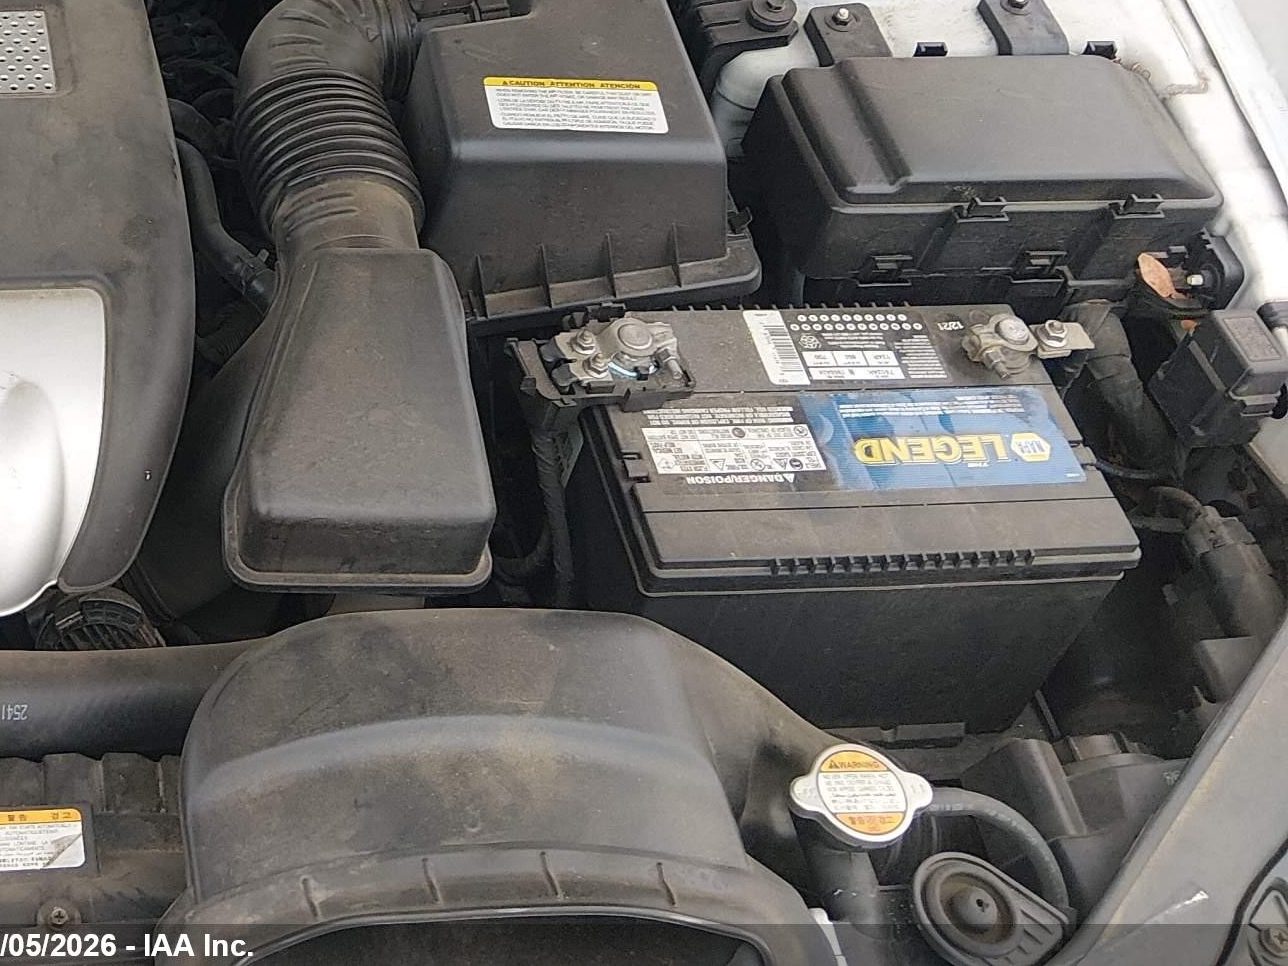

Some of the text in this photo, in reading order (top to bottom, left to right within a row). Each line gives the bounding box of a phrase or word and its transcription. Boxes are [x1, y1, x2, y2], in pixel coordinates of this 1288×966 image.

[937, 321, 964, 330] 12/21
[854, 433, 1011, 466] LEGEND
[685, 473, 783, 483] DANGER/POISON
[839, 761, 879, 769] WARNING
